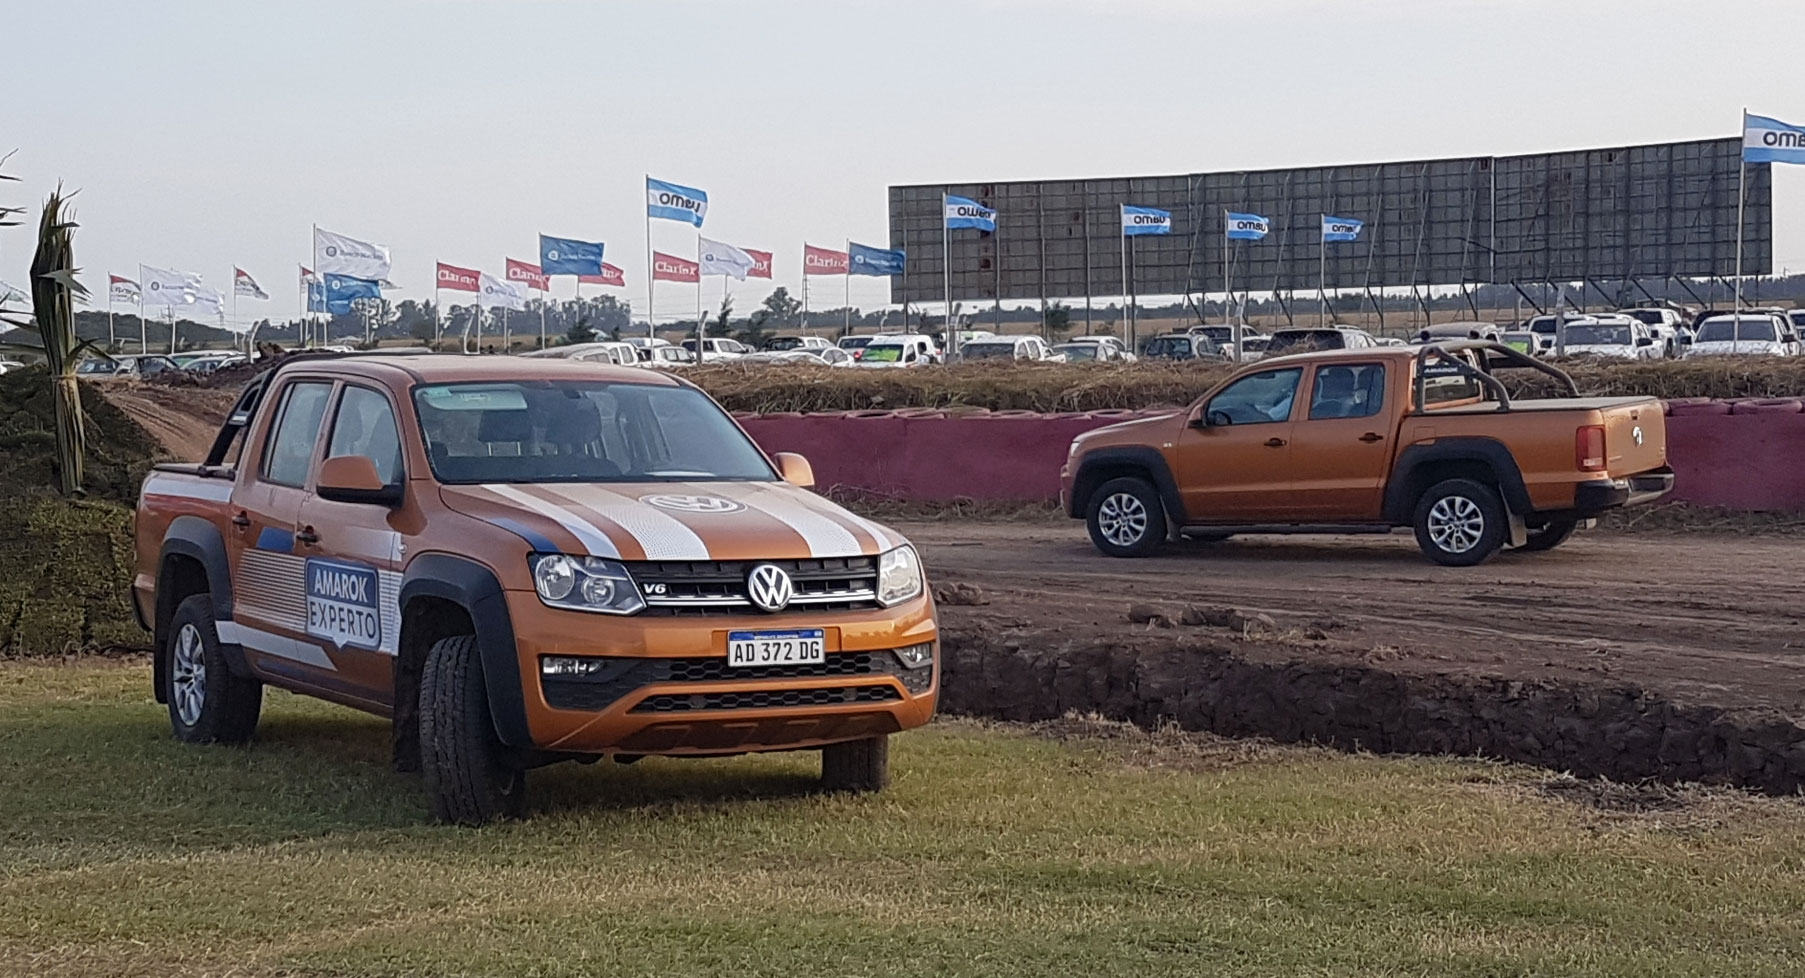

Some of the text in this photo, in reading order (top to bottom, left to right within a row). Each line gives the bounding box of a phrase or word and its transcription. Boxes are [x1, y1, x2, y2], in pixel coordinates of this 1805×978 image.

[1762, 131, 1805, 147] OMB
[314, 568, 368, 603] AMAROK
[643, 583, 666, 594] V6
[309, 601, 377, 639] EXPERTO
[734, 641, 820, 663] AD 372 DG
